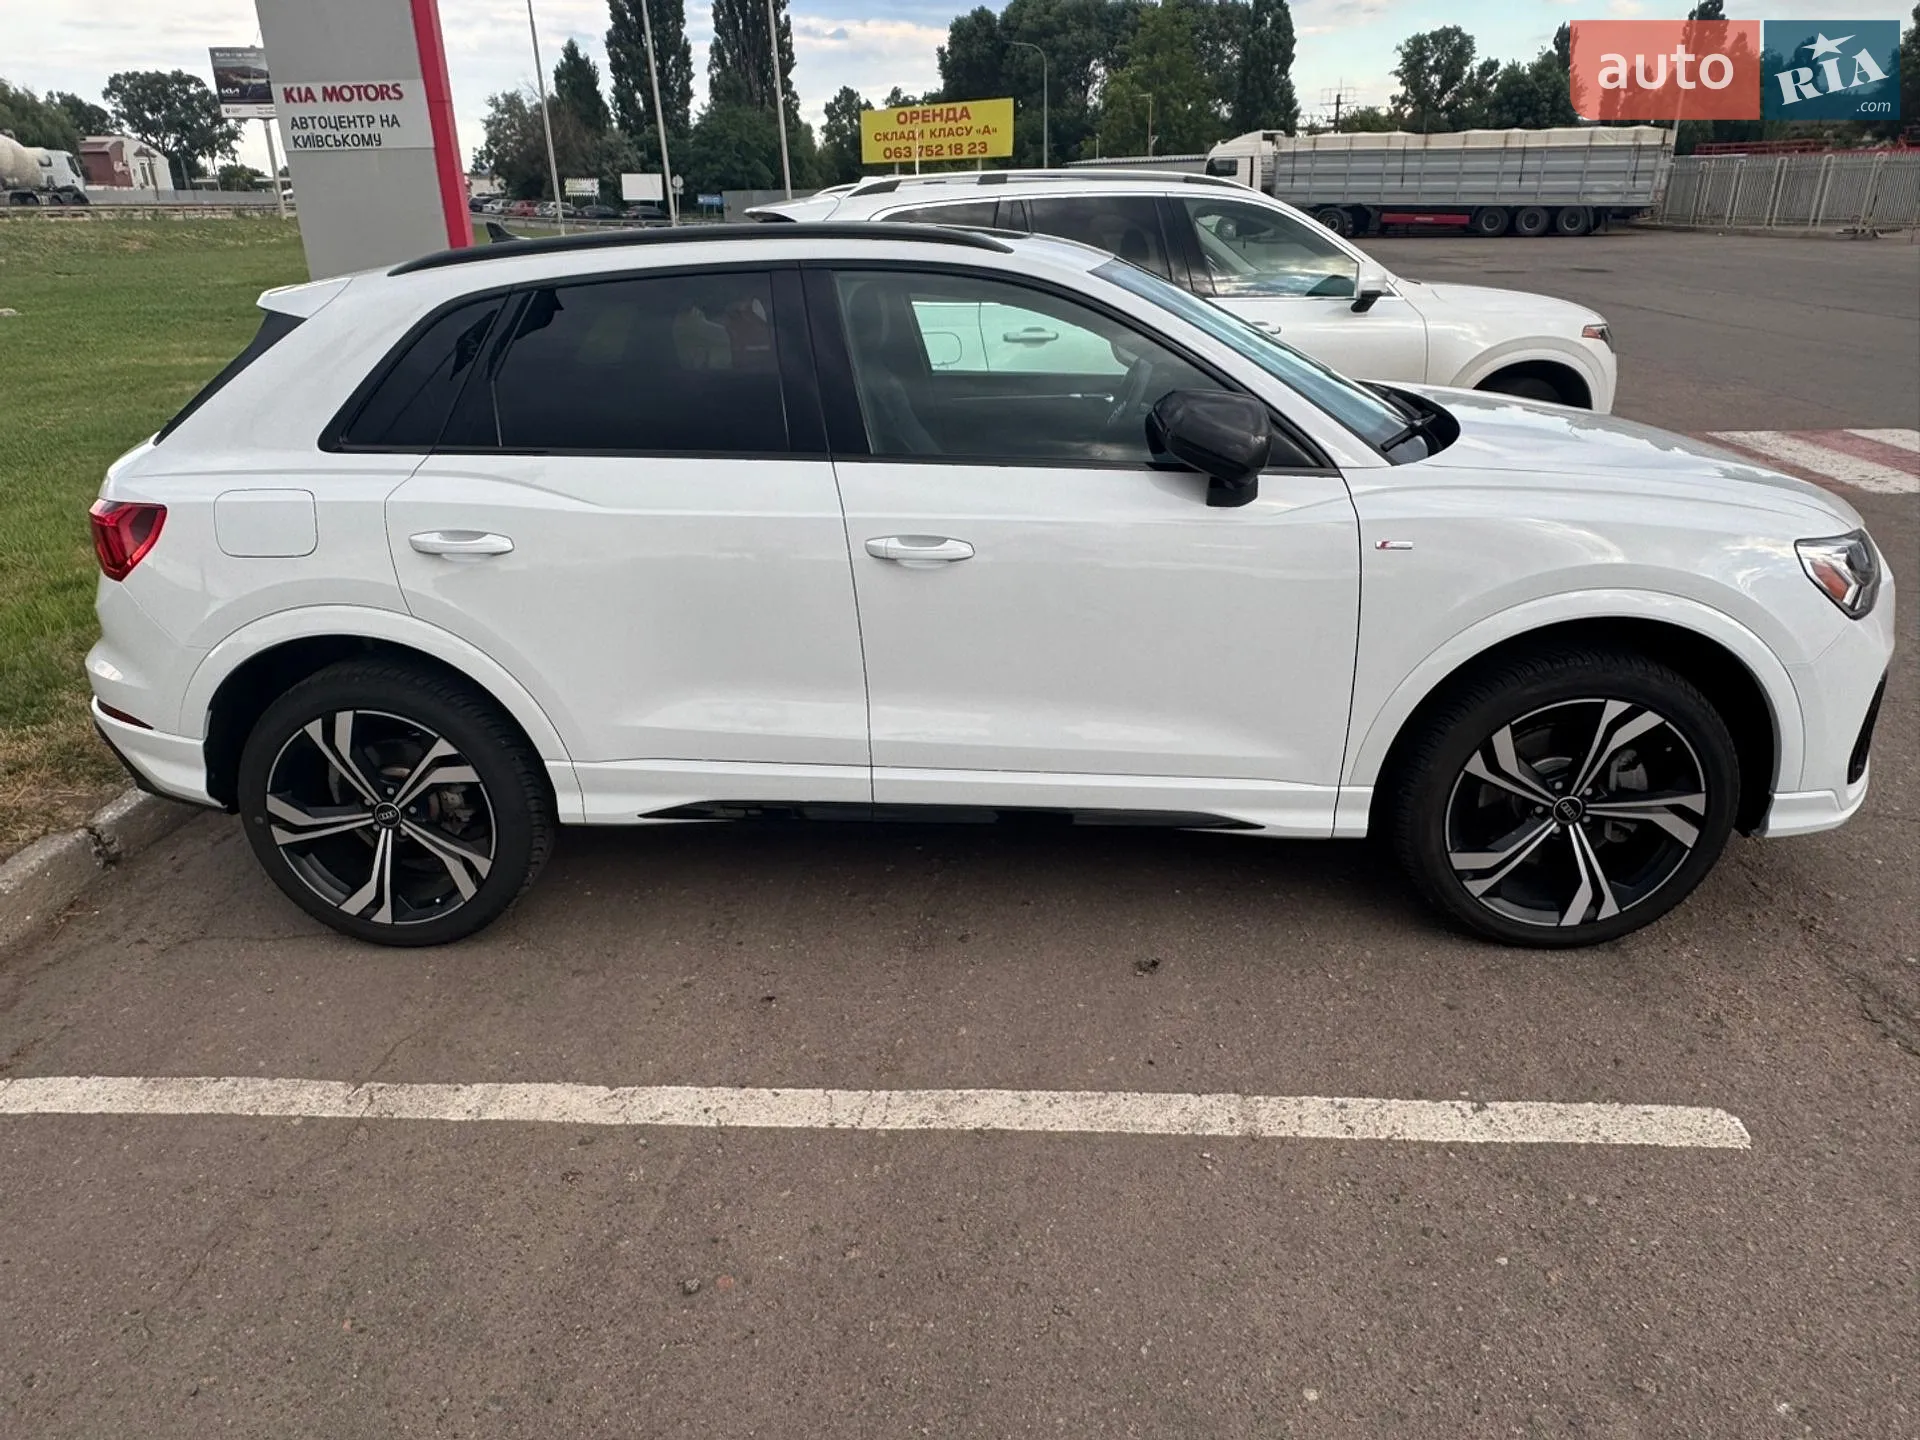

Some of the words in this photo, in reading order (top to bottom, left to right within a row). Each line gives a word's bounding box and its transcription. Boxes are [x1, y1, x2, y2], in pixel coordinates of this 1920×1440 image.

[283, 86, 317, 104] KIA
[322, 82, 404, 103] MOTORS
[290, 114, 376, 132] АВТОЦЕНТР
[379, 113, 401, 128] НА
[896, 106, 971, 125] ОРЕНДА
[292, 132, 383, 149] КИЇВСЬКОМУ
[874, 128, 924, 142] СКЛАДИ
[929, 126, 974, 138] КЛАСУ
[883, 146, 912, 160] 063
[917, 144, 945, 157] 752
[948, 143, 963, 156] 18
[967, 141, 988, 155] 23
